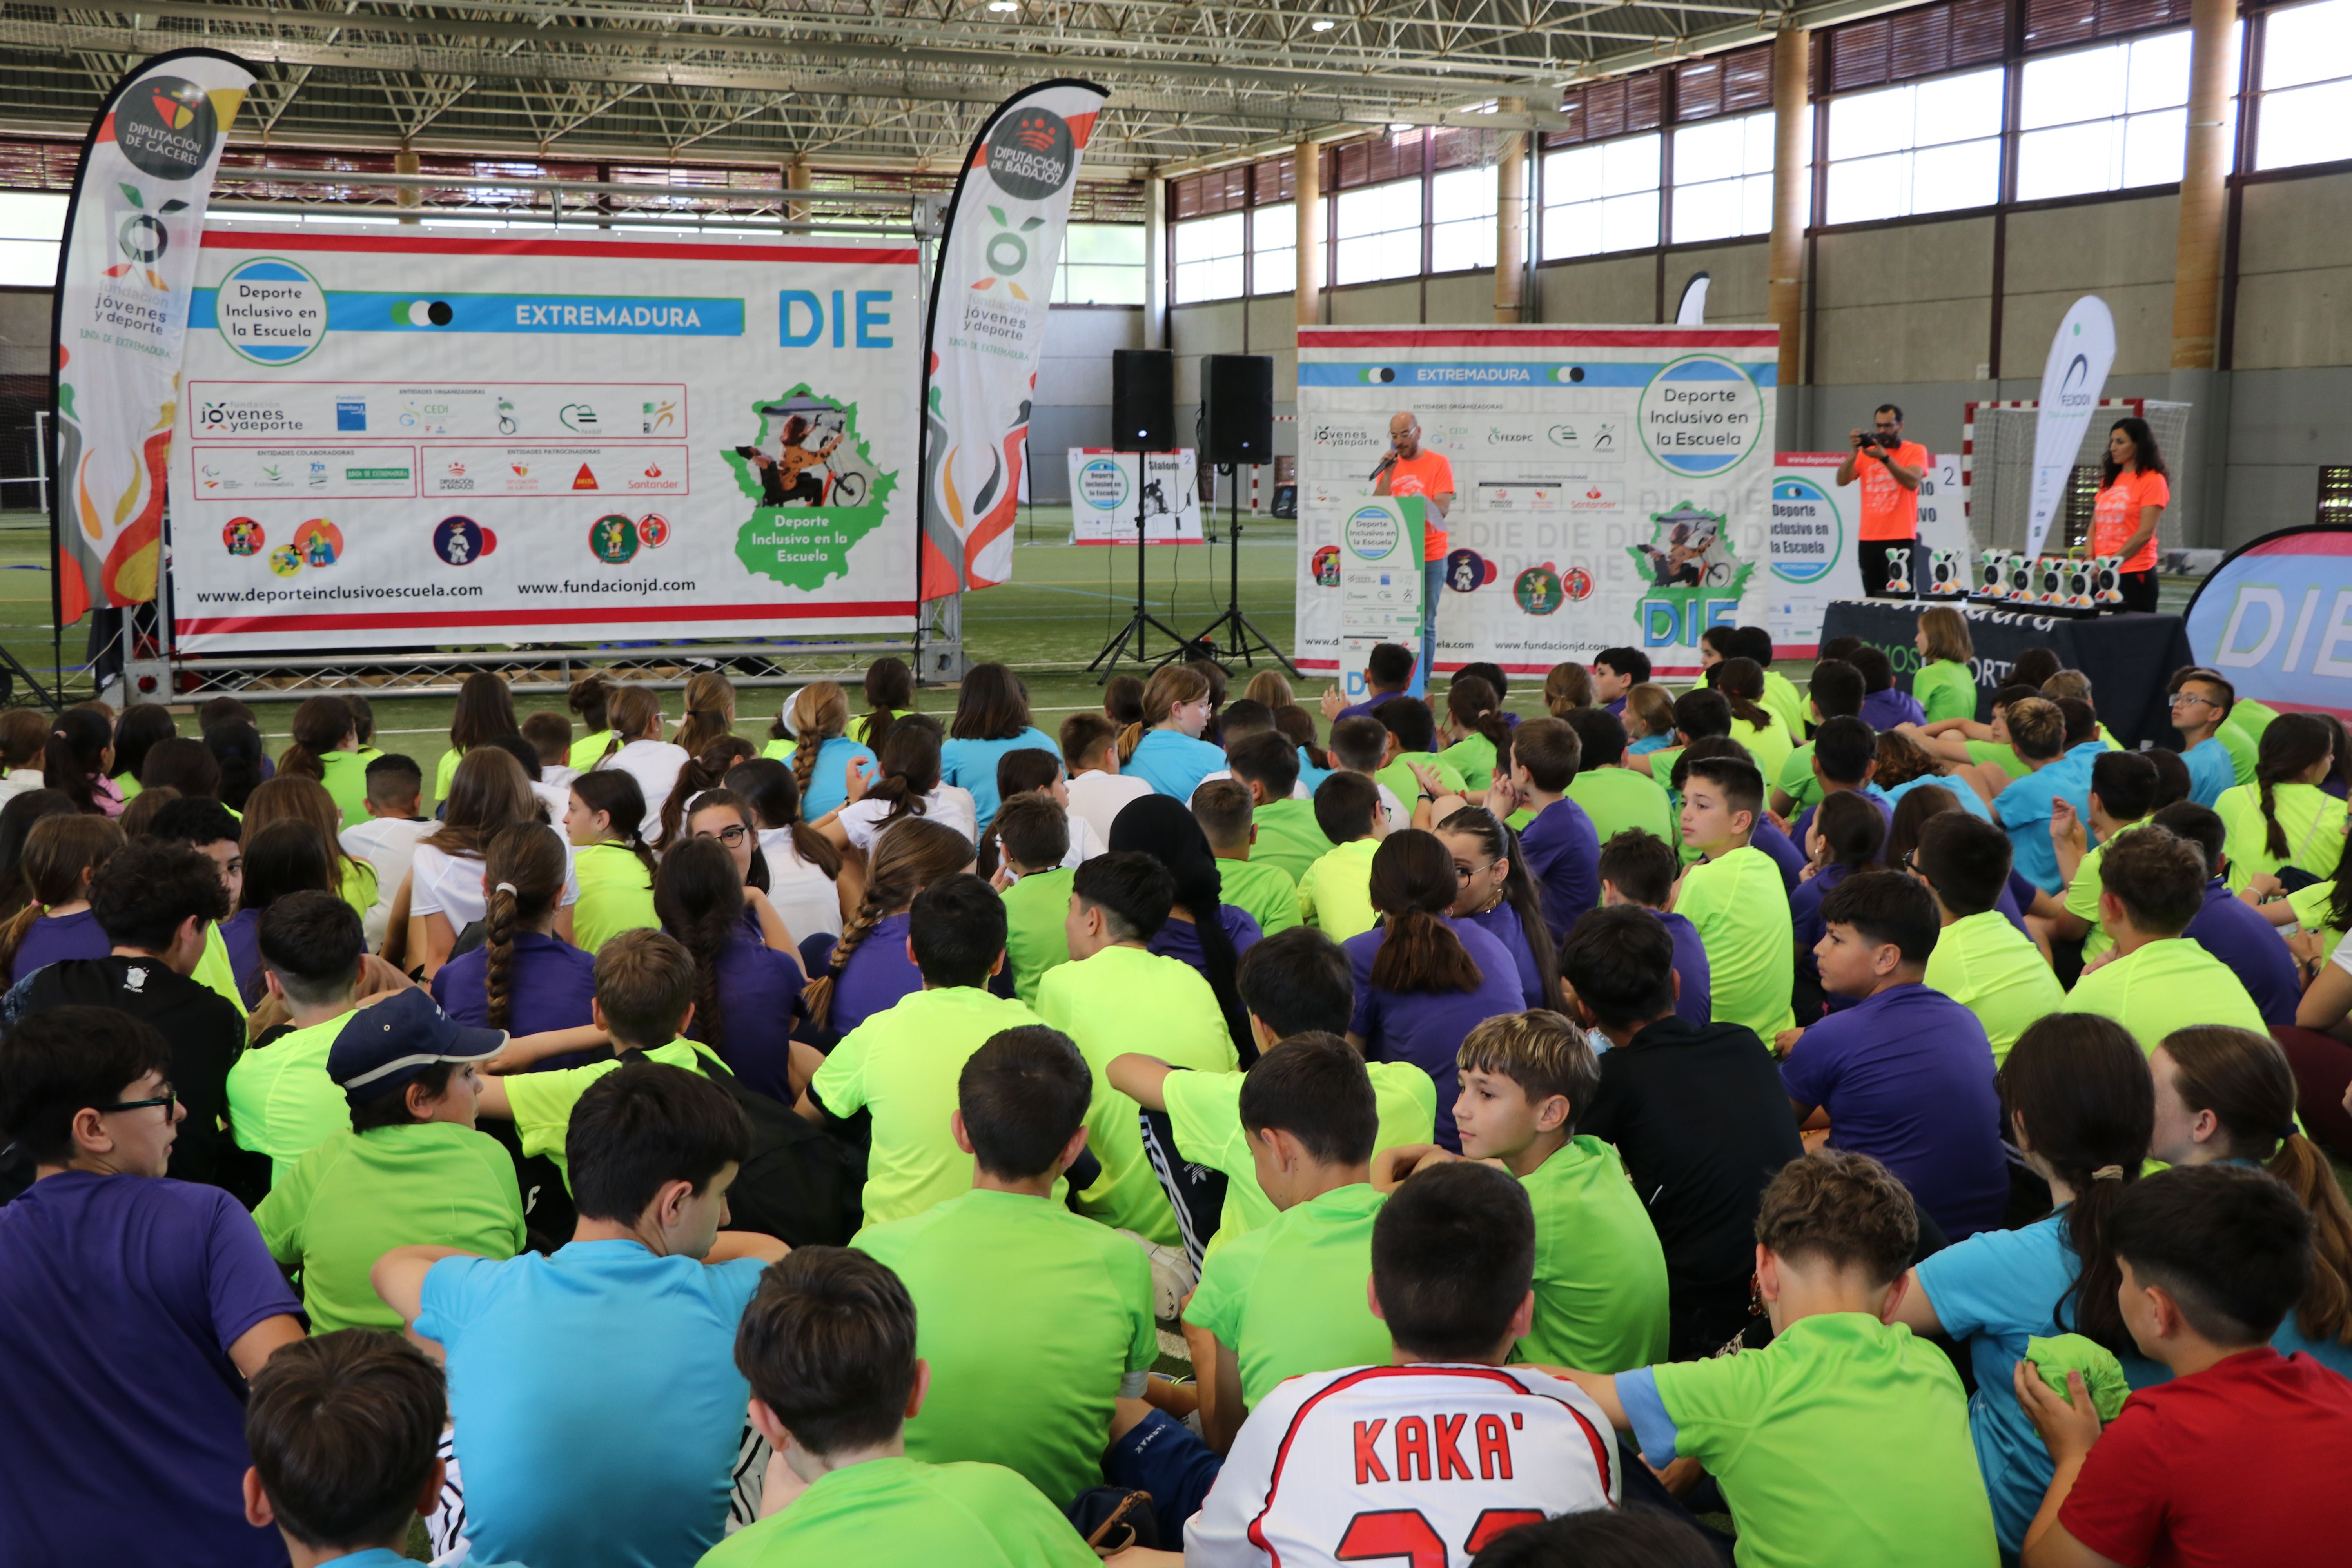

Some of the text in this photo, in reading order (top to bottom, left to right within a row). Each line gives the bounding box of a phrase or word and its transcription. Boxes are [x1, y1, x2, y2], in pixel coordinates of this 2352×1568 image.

[125, 134, 142, 147] DE
[129, 122, 202, 154] DIPUTACIÓN
[994, 146, 1065, 174] DIPUTACIÓN
[991, 160, 1062, 186] DE BADAJOZ
[240, 285, 302, 301] Deporte
[94, 293, 166, 323] jóvenes
[226, 304, 293, 317] Inclusivo
[94, 310, 163, 335] y deporte
[516, 305, 701, 328] EXTREMADURA
[779, 290, 893, 348] DIE
[965, 305, 1026, 329] jóvenes
[233, 323, 312, 337] la Escuela
[964, 321, 1023, 341] y deporte
[103, 333, 113, 343] DE
[116, 336, 171, 358] EXTREMADURA
[949, 336, 1030, 361] JUNTA DE EXTREMADURA
[1417, 369, 1530, 381] EXTREMADURA
[230, 400, 280, 408] fundación
[1664, 389, 1736, 405] Deporte
[200, 406, 284, 423] jóvenes
[424, 405, 449, 414] CEDI
[1651, 410, 1748, 424] Inclusivo en
[1657, 432, 1740, 445] la Escuela
[1074, 454, 1079, 462] 1
[1149, 461, 1179, 470] Slalom
[1184, 454, 1191, 465] 2
[1944, 467, 1955, 485] 2
[628, 480, 679, 489] Santander
[1571, 501, 1616, 509] Santander
[1773, 504, 1815, 517] Deporte
[775, 515, 829, 529] Deporte
[1815, 524, 1828, 535] en
[752, 531, 848, 545] Inclusivo en la
[1470, 522, 1591, 548] DIE DIE
[1771, 541, 1824, 553] la Escuela
[777, 550, 828, 562] Escuela
[198, 584, 483, 603] www.deporteinclusivoescuela.com
[518, 579, 696, 596] www.fundacionjd.com
[1643, 599, 1738, 647] DIE
[2212, 583, 2352, 678] DIE
[1495, 641, 1610, 651] www.fundacionjd.com
[1354, 1412, 1523, 1484] KAKA'
